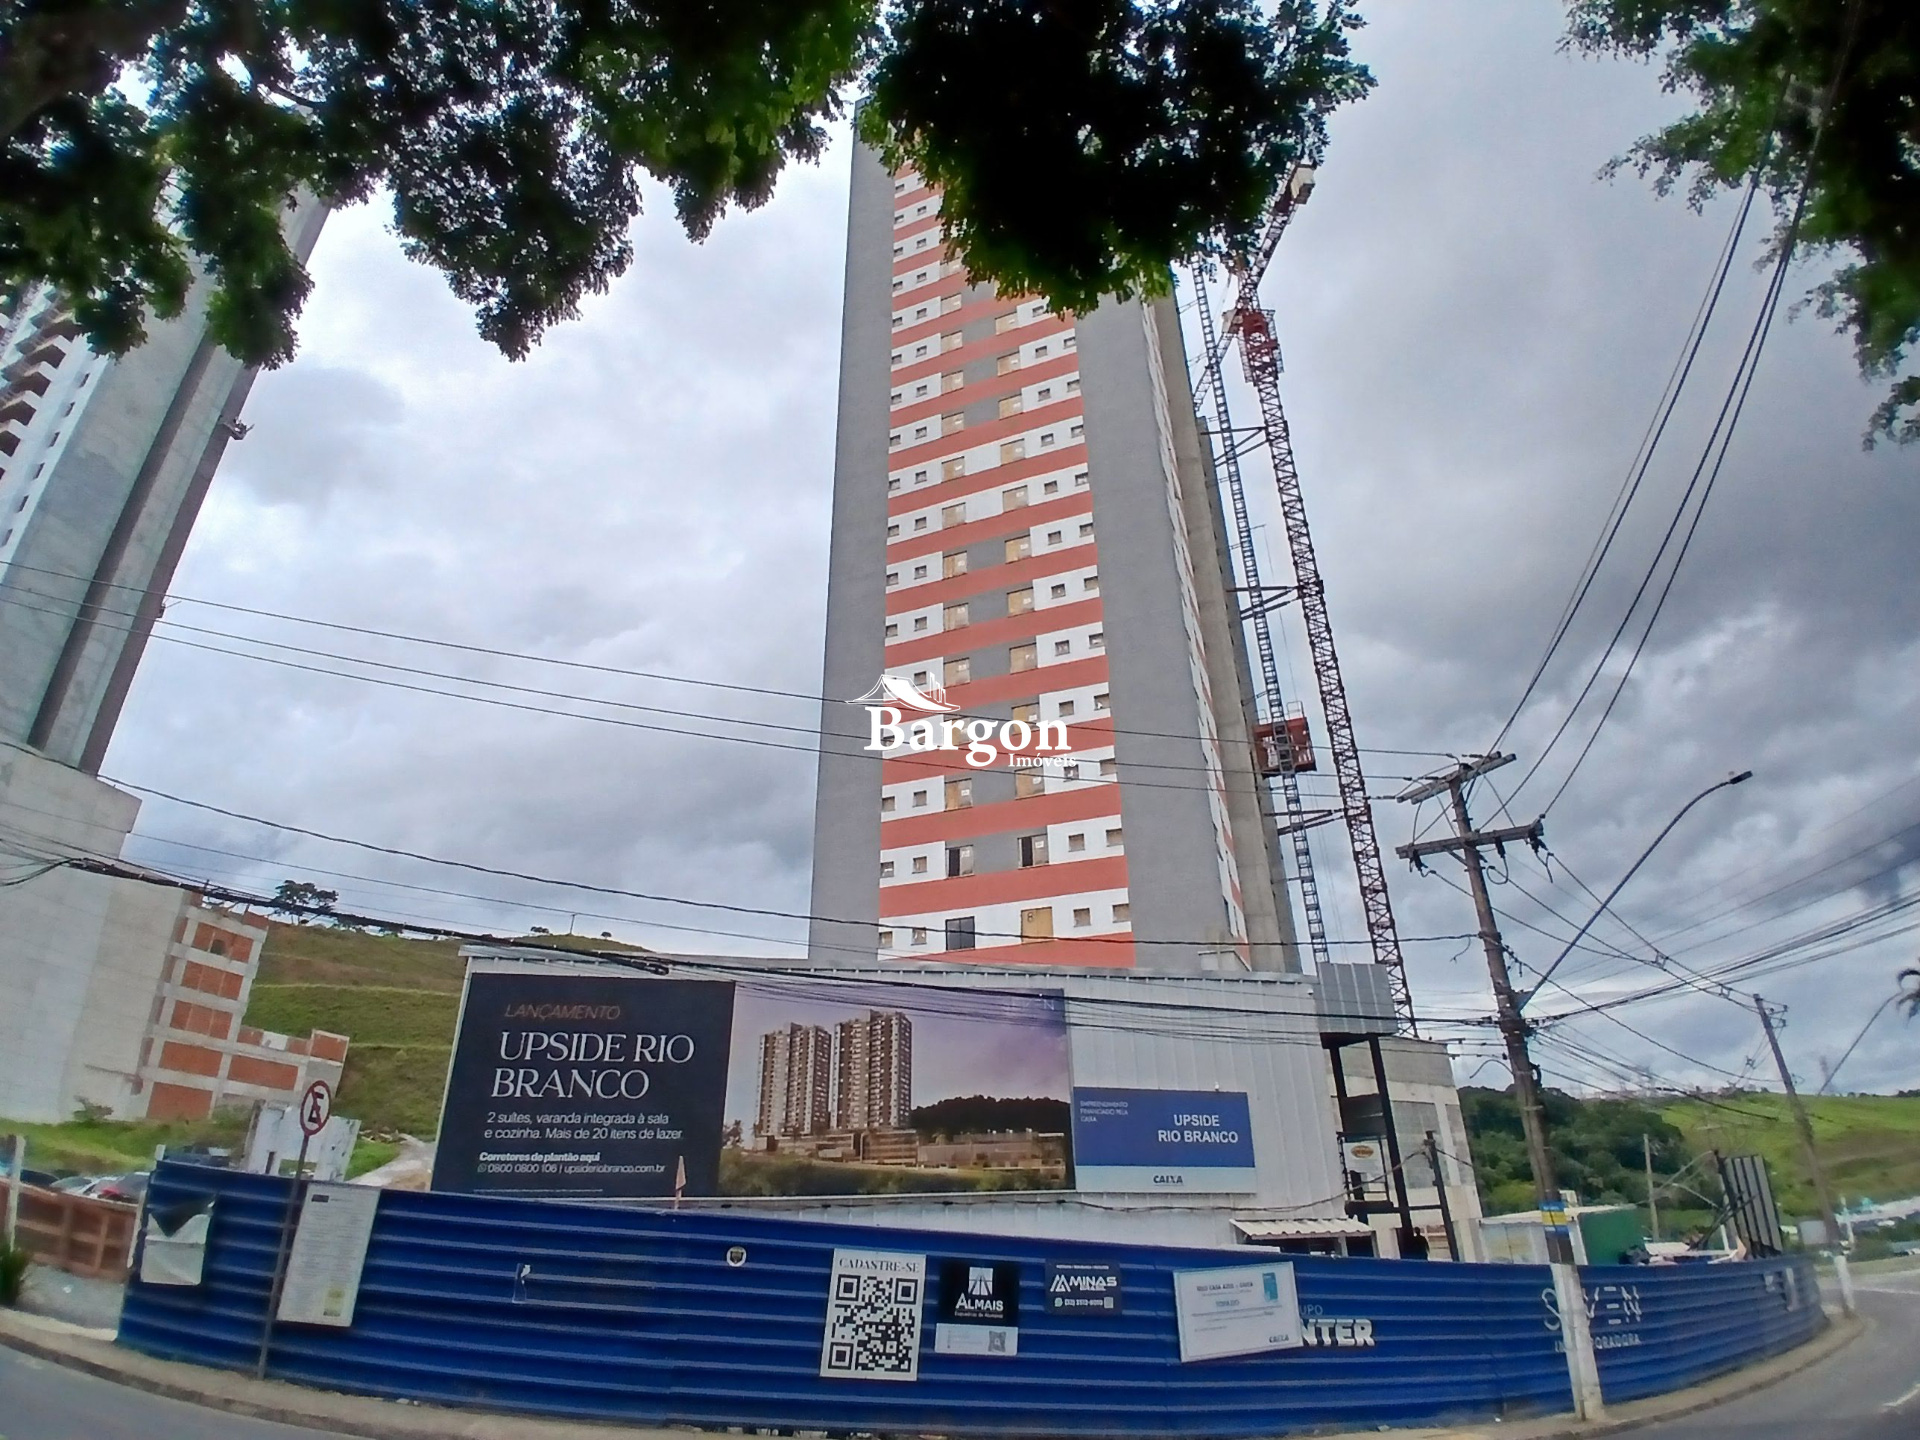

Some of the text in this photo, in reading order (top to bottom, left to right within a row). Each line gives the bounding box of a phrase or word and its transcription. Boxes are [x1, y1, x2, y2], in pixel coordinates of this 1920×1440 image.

[504, 1003, 621, 1020] LANÇAMENTO
[500, 1031, 695, 1063] UPSIDE RIO
[491, 1068, 650, 1099] BRANCO
[487, 1111, 496, 1123] 2
[536, 1112, 581, 1124] varanda
[583, 1113, 636, 1126] integrada
[647, 1113, 669, 1124] sala
[1173, 1114, 1221, 1127] UPSIDE
[484, 1129, 493, 1139] e
[545, 1128, 572, 1139] Mais
[574, 1128, 590, 1139] de
[592, 1128, 608, 1139] 20
[610, 1128, 637, 1139] itens
[638, 1128, 655, 1139] de
[1158, 1130, 1239, 1143] RIO BRANCO
[479, 1152, 601, 1163] Corretores de plantão aqui
[1153, 1175, 1184, 1184] CAIXA
[839, 1259, 920, 1273] CADASTRE-SE
[1069, 1276, 1117, 1287] MINAS
[955, 1292, 1004, 1312] ALMAIS
[1541, 1286, 1642, 1331] SVEN
[1300, 1304, 1323, 1315] UPO
[1301, 1318, 1375, 1347] NTER
